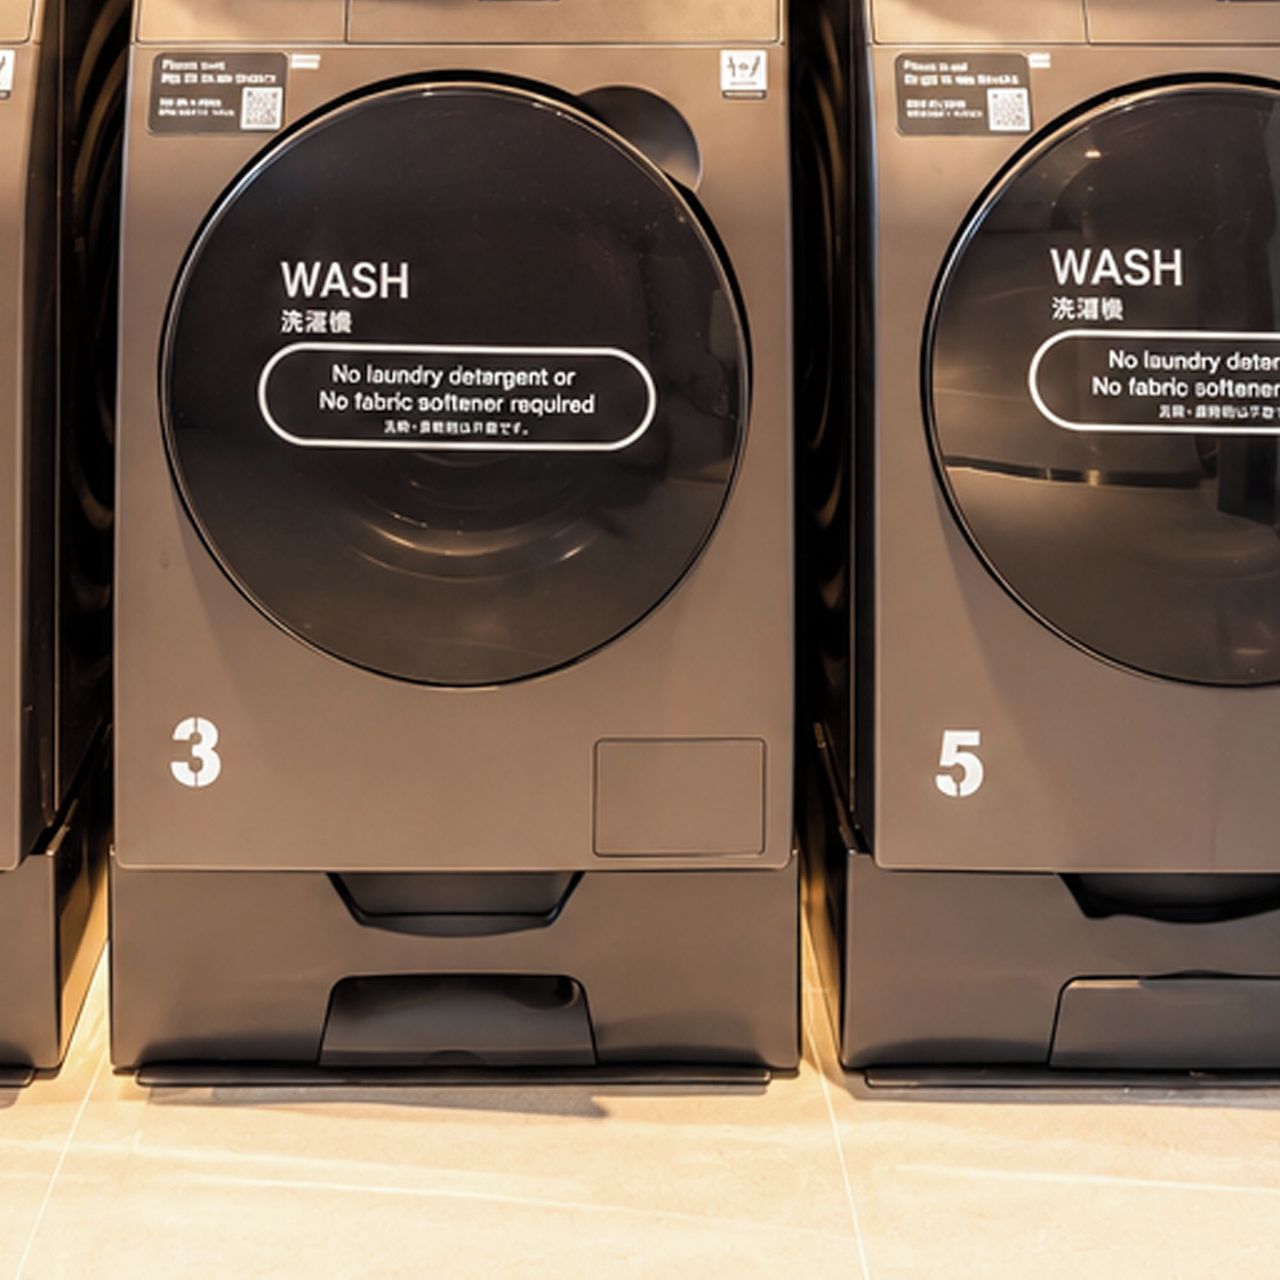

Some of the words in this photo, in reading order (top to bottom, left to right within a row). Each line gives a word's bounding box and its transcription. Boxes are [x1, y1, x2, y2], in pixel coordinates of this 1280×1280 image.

[281, 262, 408, 298] WASH
[1051, 249, 1182, 285] WASH
[1109, 350, 1138, 369] No
[1144, 350, 1220, 374] laundry
[333, 365, 360, 383] No
[367, 365, 443, 388] laundry
[449, 366, 548, 390] detergent
[554, 372, 576, 386] or
[1093, 377, 1121, 395] No
[1129, 377, 1188, 397] fabric
[1196, 379, 1280, 397] softener
[320, 391, 348, 410] No
[355, 392, 412, 411] fabric
[418, 394, 503, 412] softener
[505, 394, 594, 416] required
[171, 718, 220, 787] 3
[936, 730, 983, 796] 5
